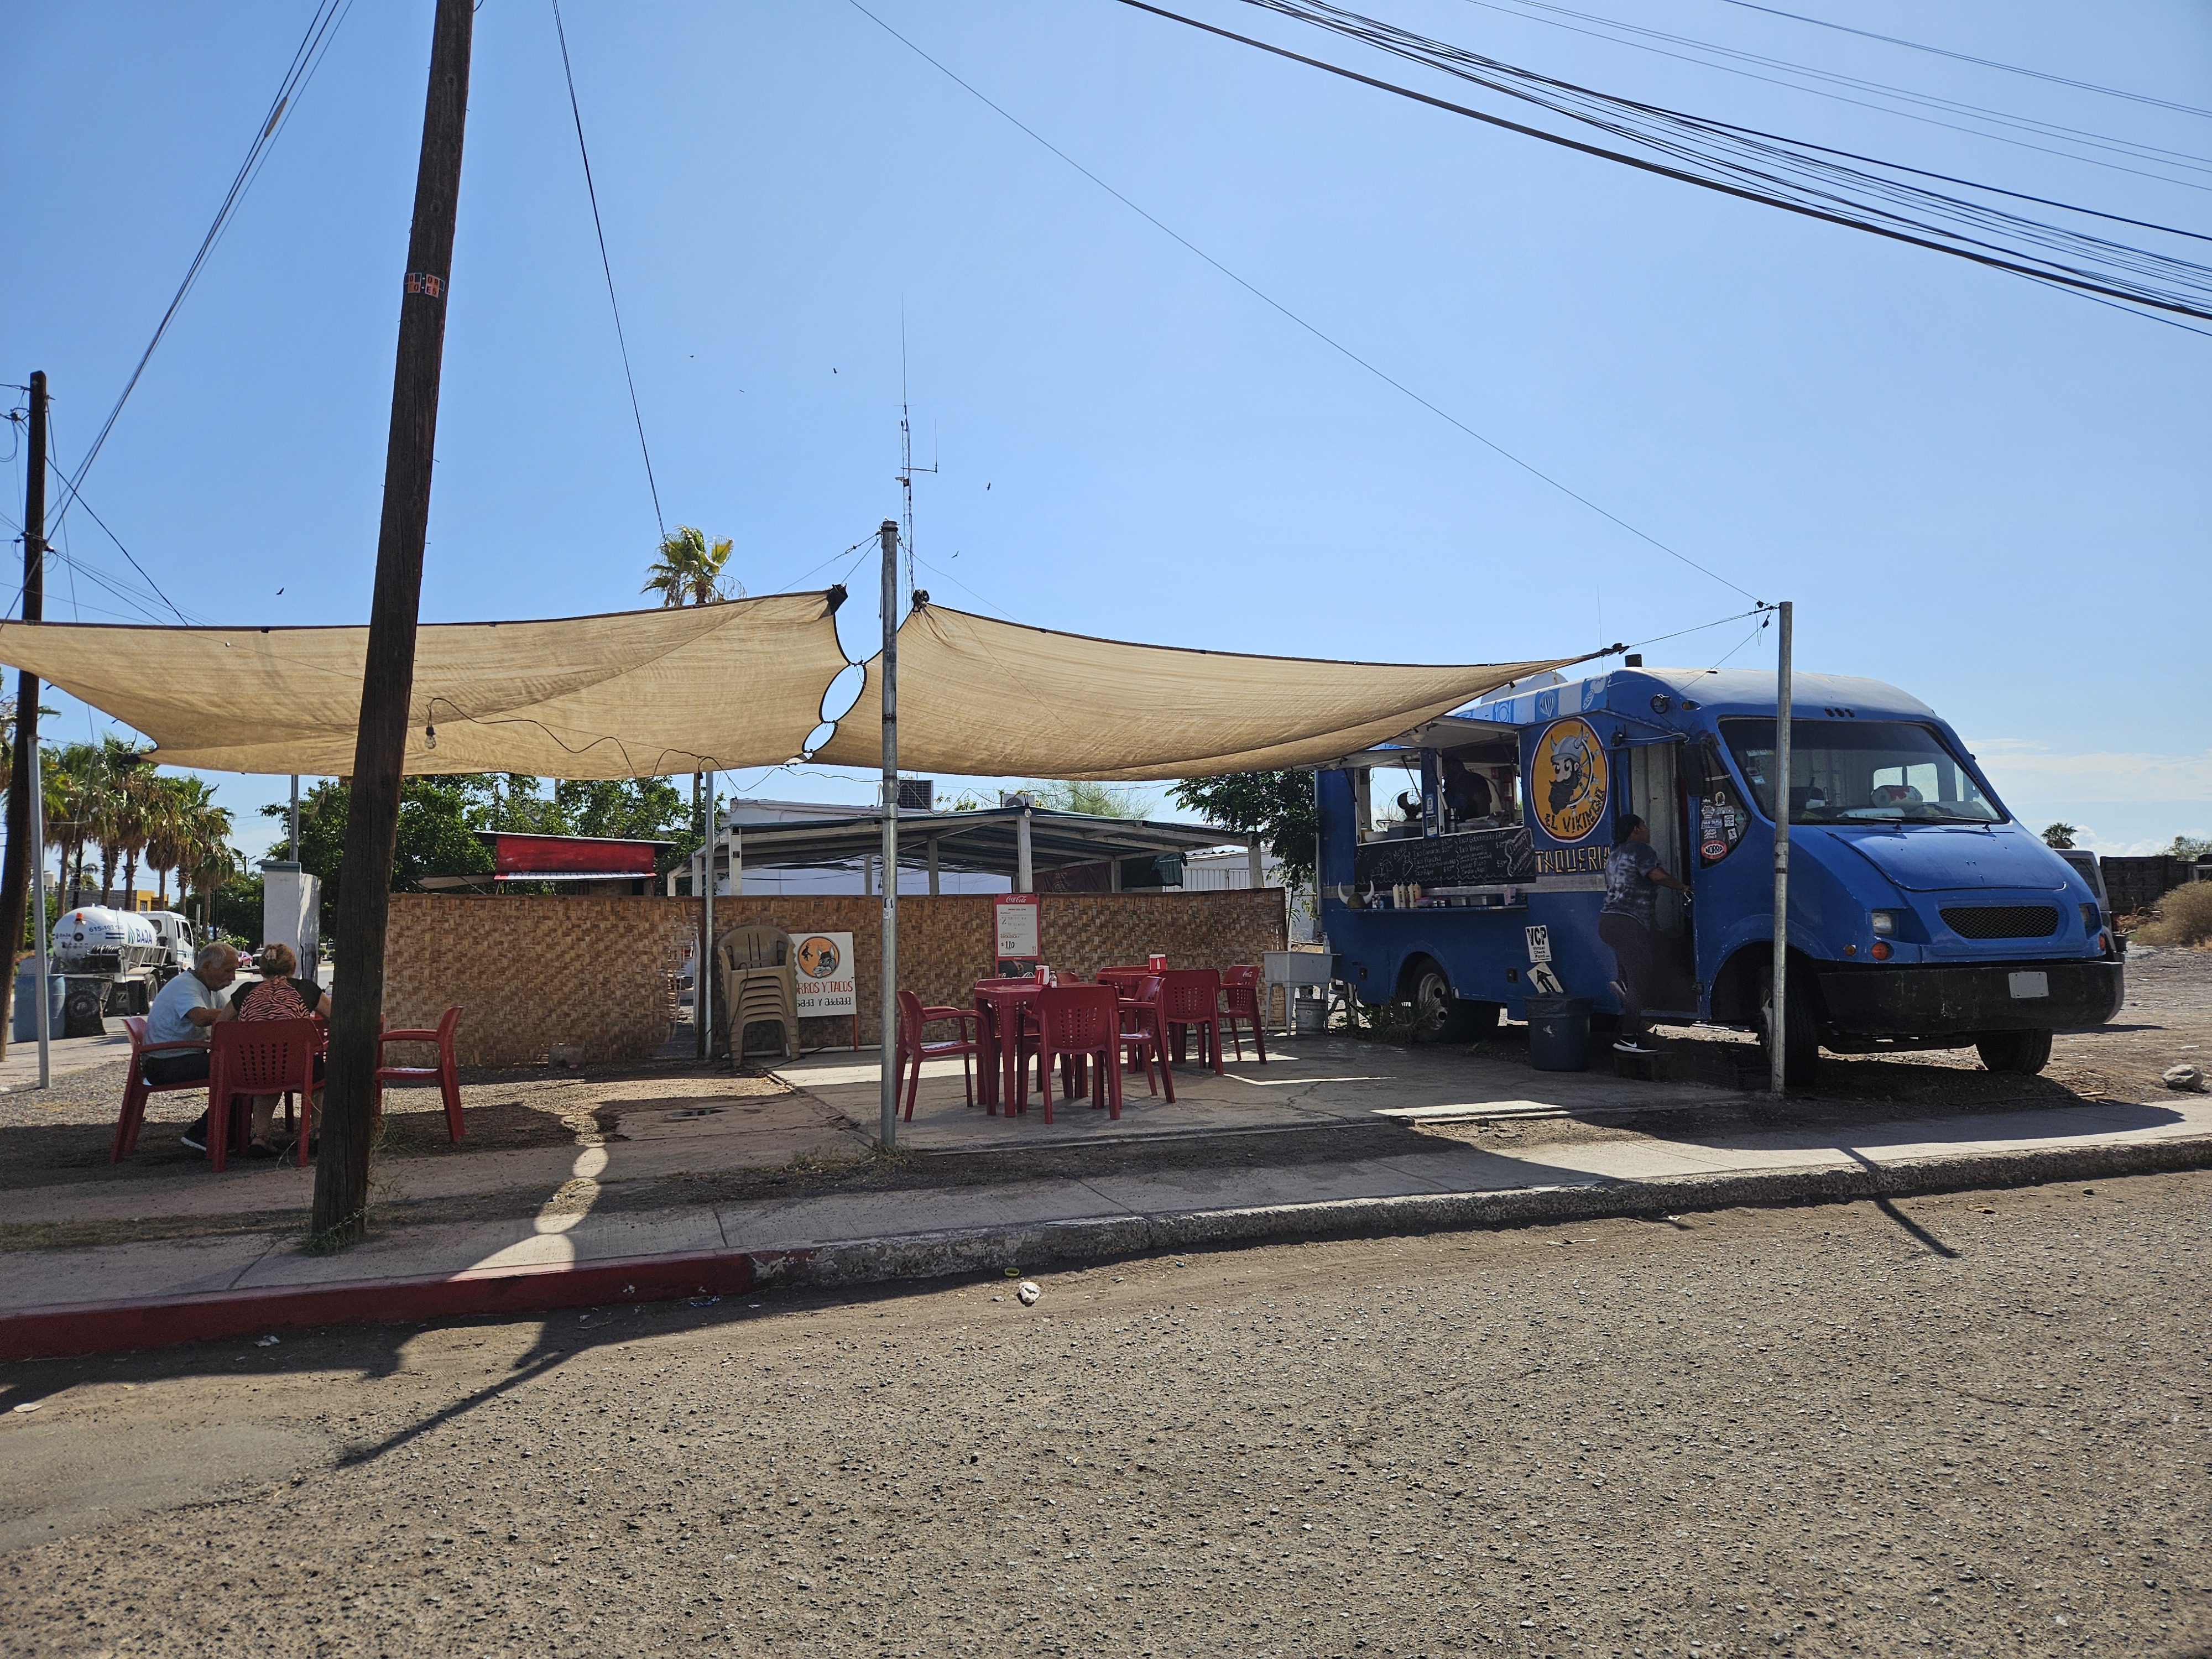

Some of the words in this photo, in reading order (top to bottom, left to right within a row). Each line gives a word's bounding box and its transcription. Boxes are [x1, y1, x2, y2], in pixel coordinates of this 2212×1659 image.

[1545, 813, 1558, 831] EL
[1535, 846, 1610, 873] TAQUERIA
[135, 928, 153, 945] BAJA
[1005, 941, 1015, 949] 110
[1526, 927, 1547, 946] VCP
[822, 982, 828, 993] Y
[828, 980, 853, 993] TACOS
[825, 997, 852, 1006] adobada
